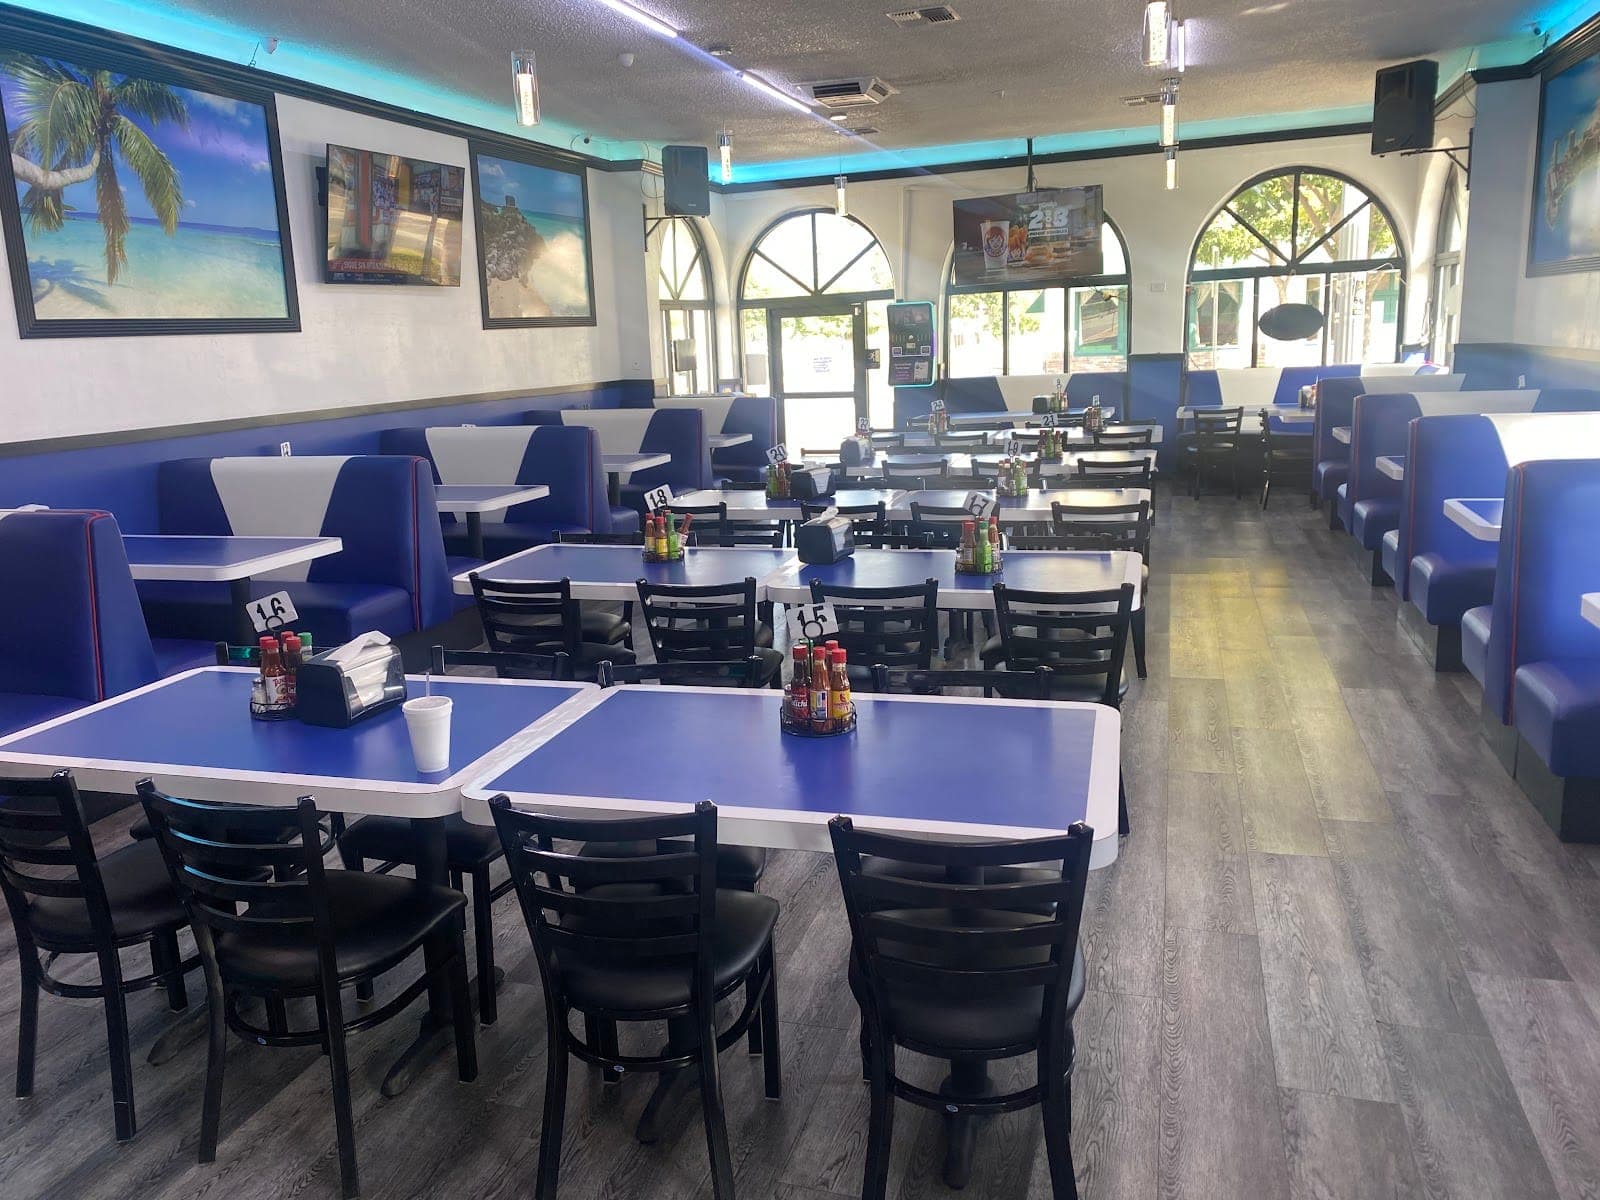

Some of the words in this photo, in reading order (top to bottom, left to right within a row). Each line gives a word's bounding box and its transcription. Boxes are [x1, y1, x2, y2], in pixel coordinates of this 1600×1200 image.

[1042, 415, 1055, 426] 21
[770, 446, 786, 460] 20
[650, 489, 668, 508] 18
[968, 495, 990, 514] 17
[256, 597, 287, 620] 16
[797, 605, 828, 627] 15
